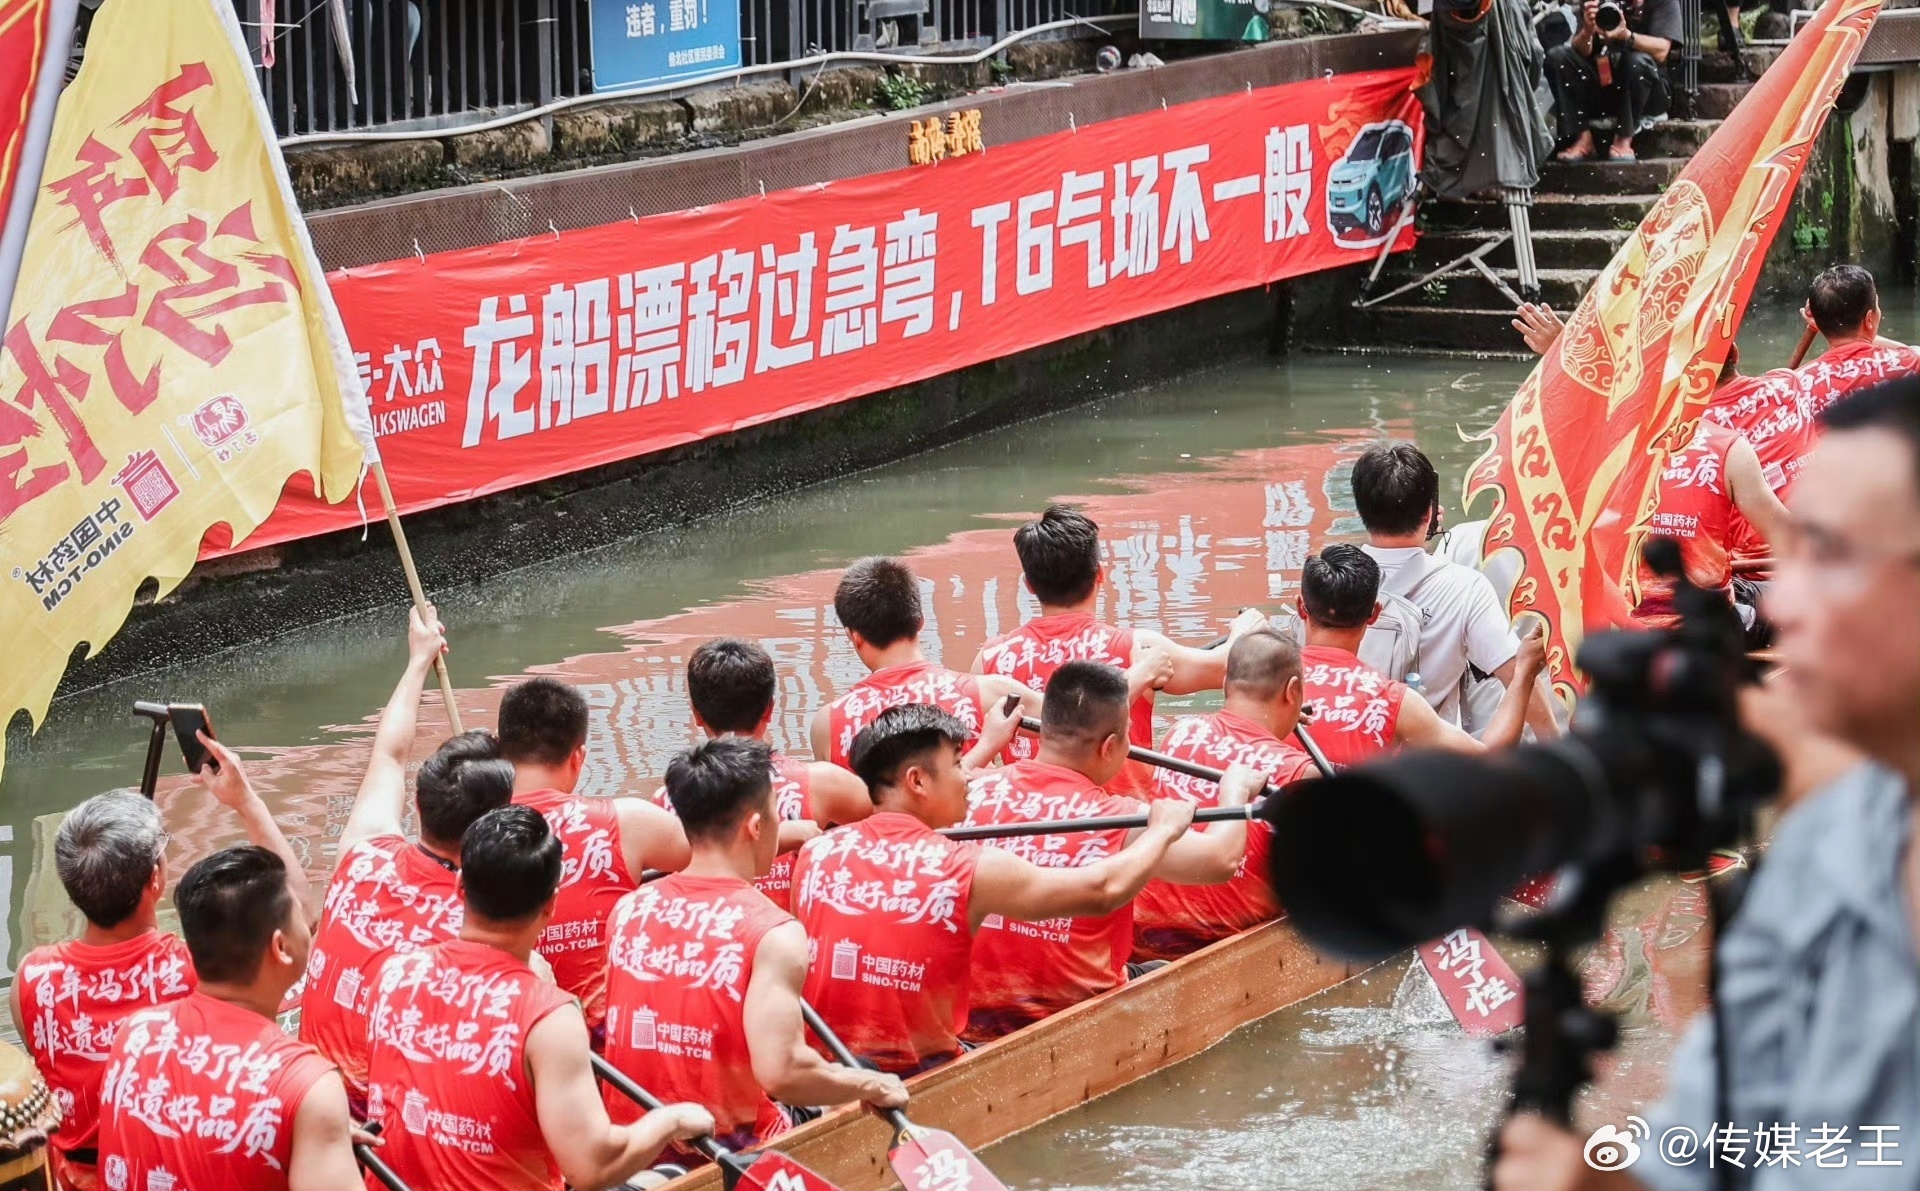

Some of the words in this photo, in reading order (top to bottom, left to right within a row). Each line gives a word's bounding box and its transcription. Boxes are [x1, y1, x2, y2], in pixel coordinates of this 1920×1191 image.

[373, 400, 446, 437] LKSWAGEN
[983, 629, 1111, 675] 百年冯了性
[832, 673, 960, 719] 百年冯了性
[1304, 664, 1381, 697] 冯了性
[803, 826, 950, 878] 百年冯了性
[754, 880, 790, 890] O-TCM
[800, 870, 960, 934] 非遗好品质
[325, 879, 433, 953] 非遗好品
[614, 887, 744, 939] 百年冯了性
[1009, 922, 1070, 943] SINO-TCM
[24, 953, 189, 1013] 百年冯了性
[378, 948, 521, 1019] 百年冯了性
[609, 930, 745, 1003] 非遗好品质
[861, 952, 925, 980] 中国药材
[861, 972, 922, 992] SINO-TCM
[124, 1010, 281, 1095] 百年冯了性
[367, 994, 520, 1092] 非遗好品质
[657, 1023, 712, 1046] 中国药材
[657, 1043, 712, 1061] SINO-TCM
[101, 1058, 282, 1169] 非遗好品质
[427, 1109, 492, 1141] 中国药材
